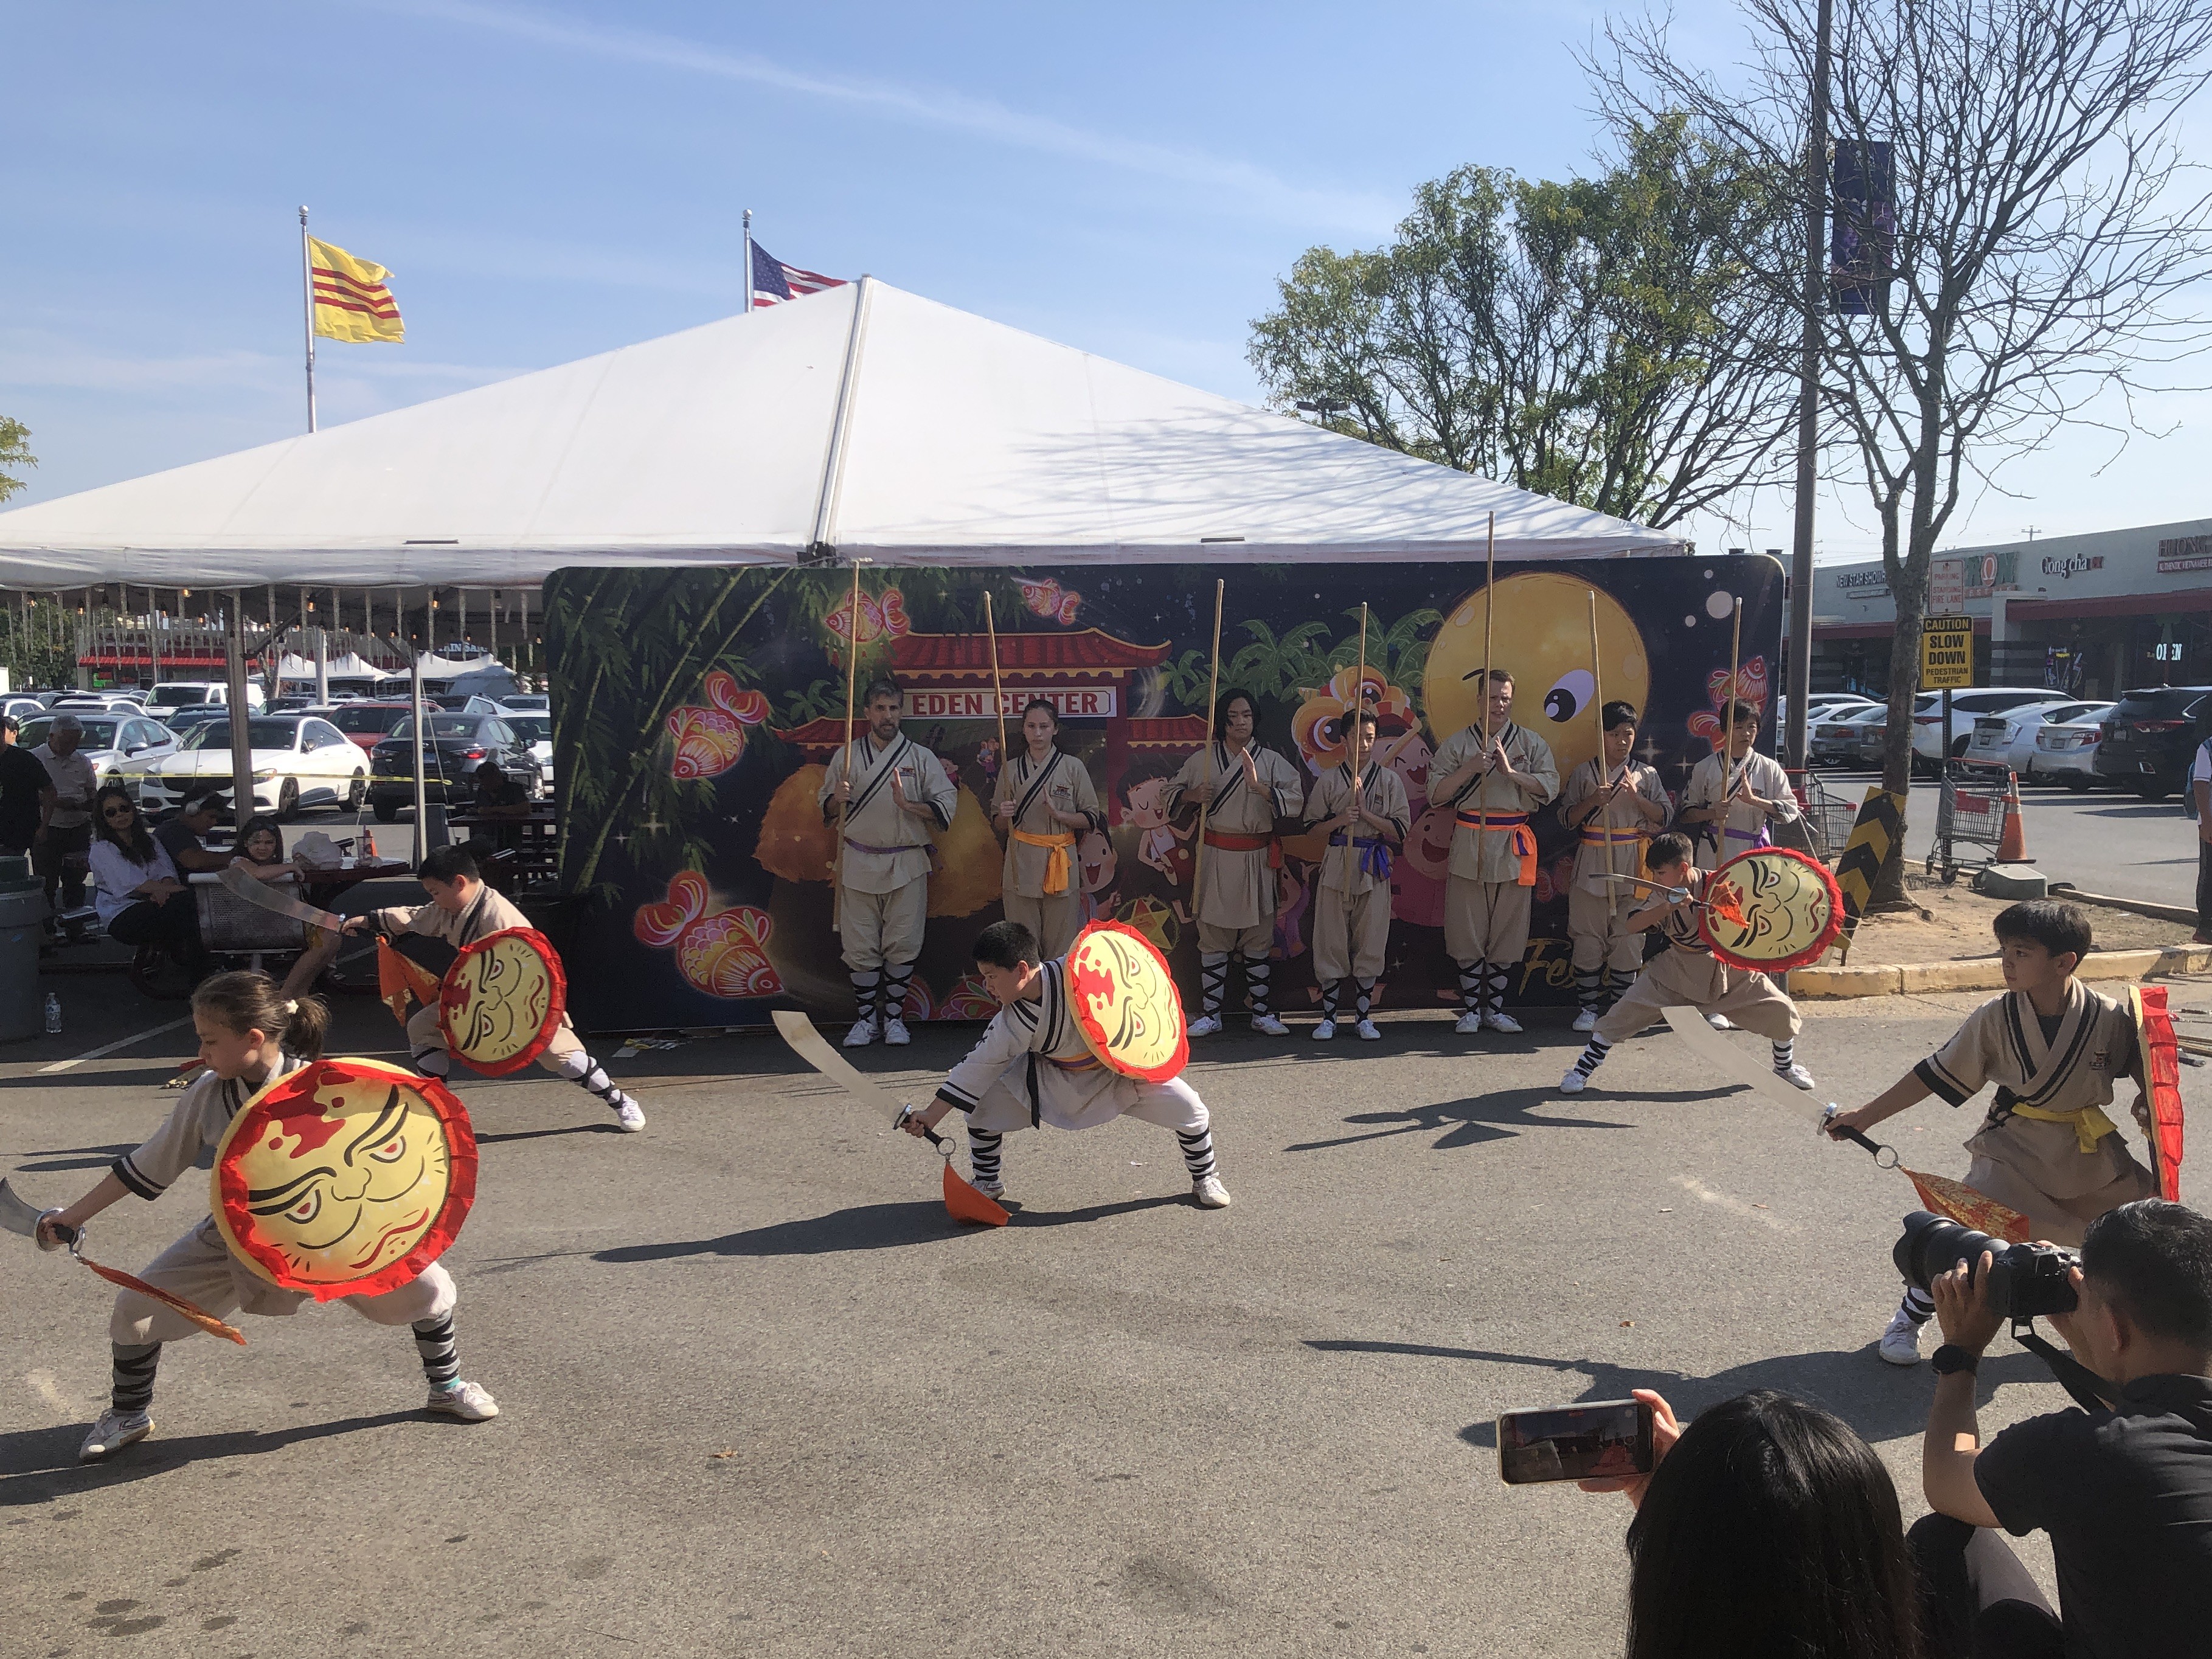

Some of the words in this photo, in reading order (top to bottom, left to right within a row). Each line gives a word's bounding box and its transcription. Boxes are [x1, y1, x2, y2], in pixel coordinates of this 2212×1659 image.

[1932, 595, 1944, 603] FIRE
[1947, 594, 1961, 603] LANE
[1925, 618, 1969, 631] CAUTION
[1929, 634, 1964, 649] SLOW
[1929, 651, 1966, 665] DOWN
[1926, 667, 1968, 676] PEDESTRIAN
[1933, 676, 1962, 684] TRAFFIC
[912, 693, 983, 715] EDEN
